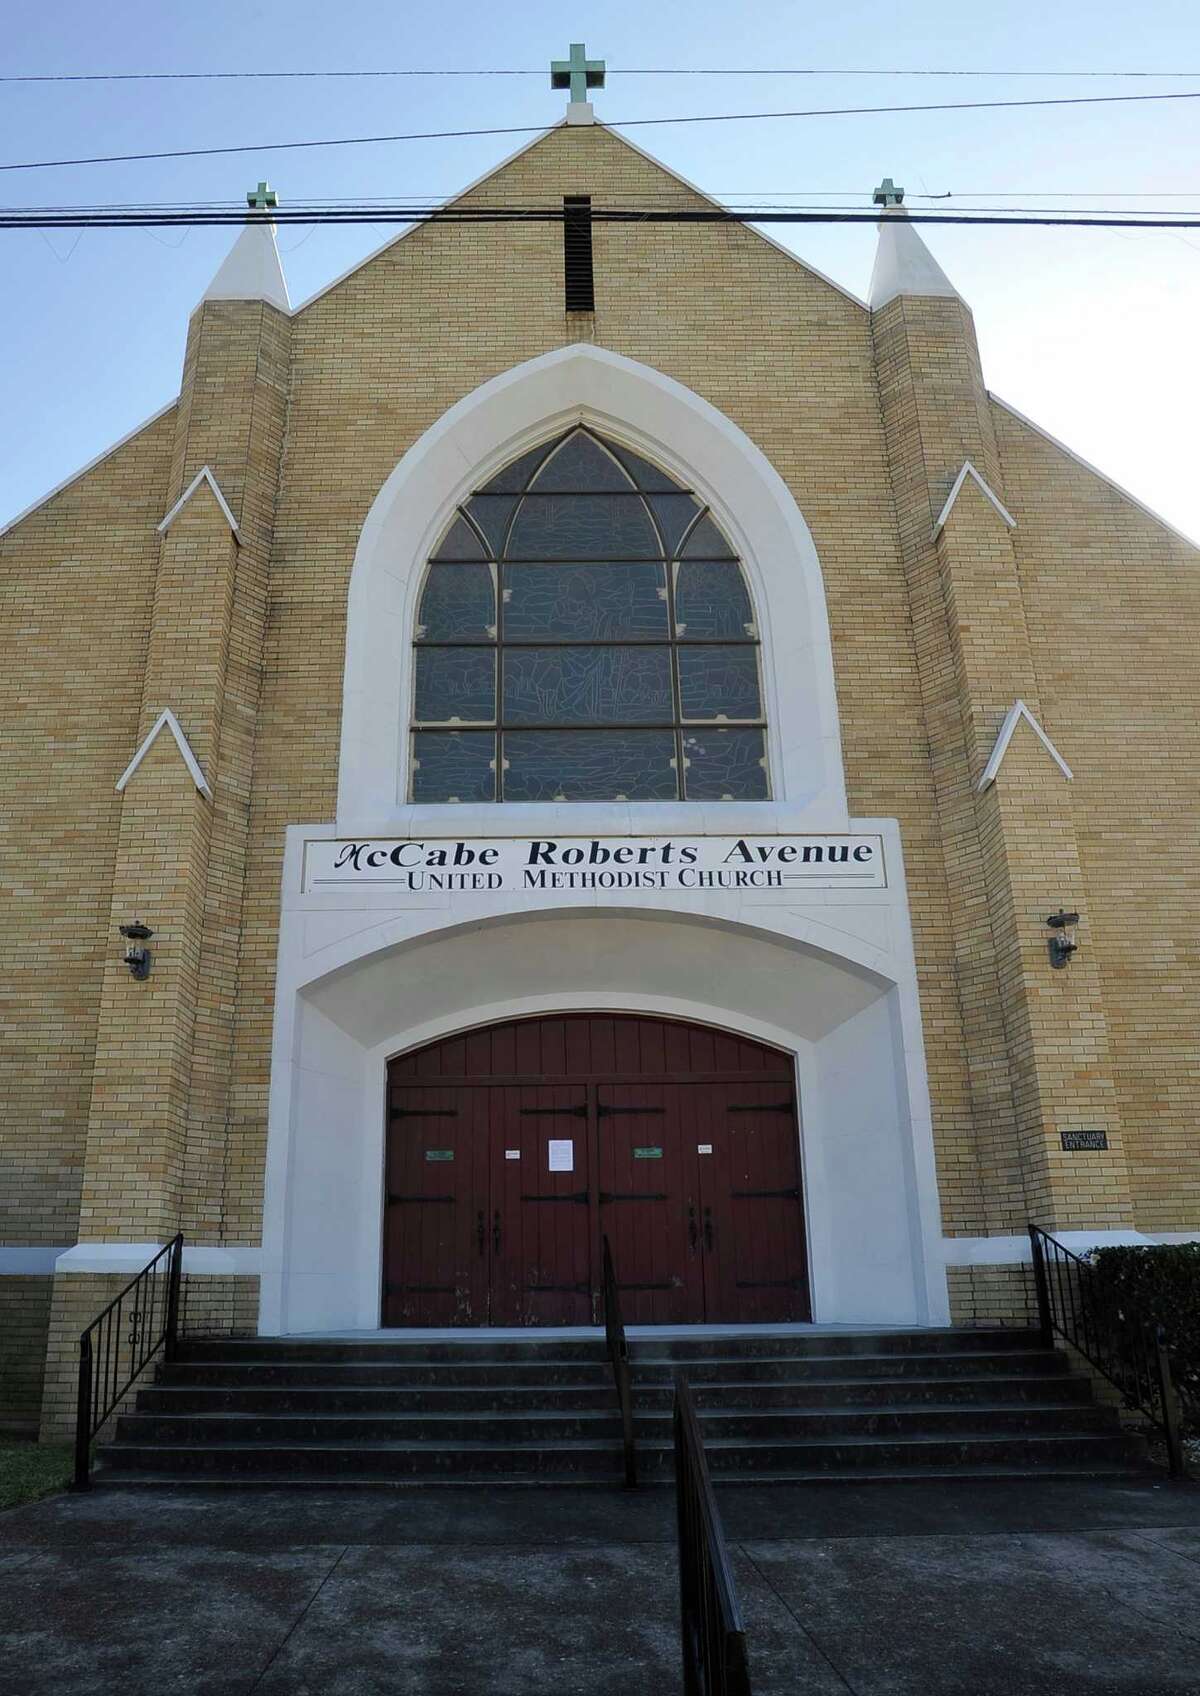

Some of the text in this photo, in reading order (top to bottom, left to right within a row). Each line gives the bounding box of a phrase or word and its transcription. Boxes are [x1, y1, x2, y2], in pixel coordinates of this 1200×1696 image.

[334, 839, 873, 871] McCabe Roberts Avenue
[407, 867, 784, 890] UNITED METHODIST CHURCH
[1062, 1132, 1104, 1141] SANCTUARY
[1064, 1140, 1105, 1149] ENTRANCE
